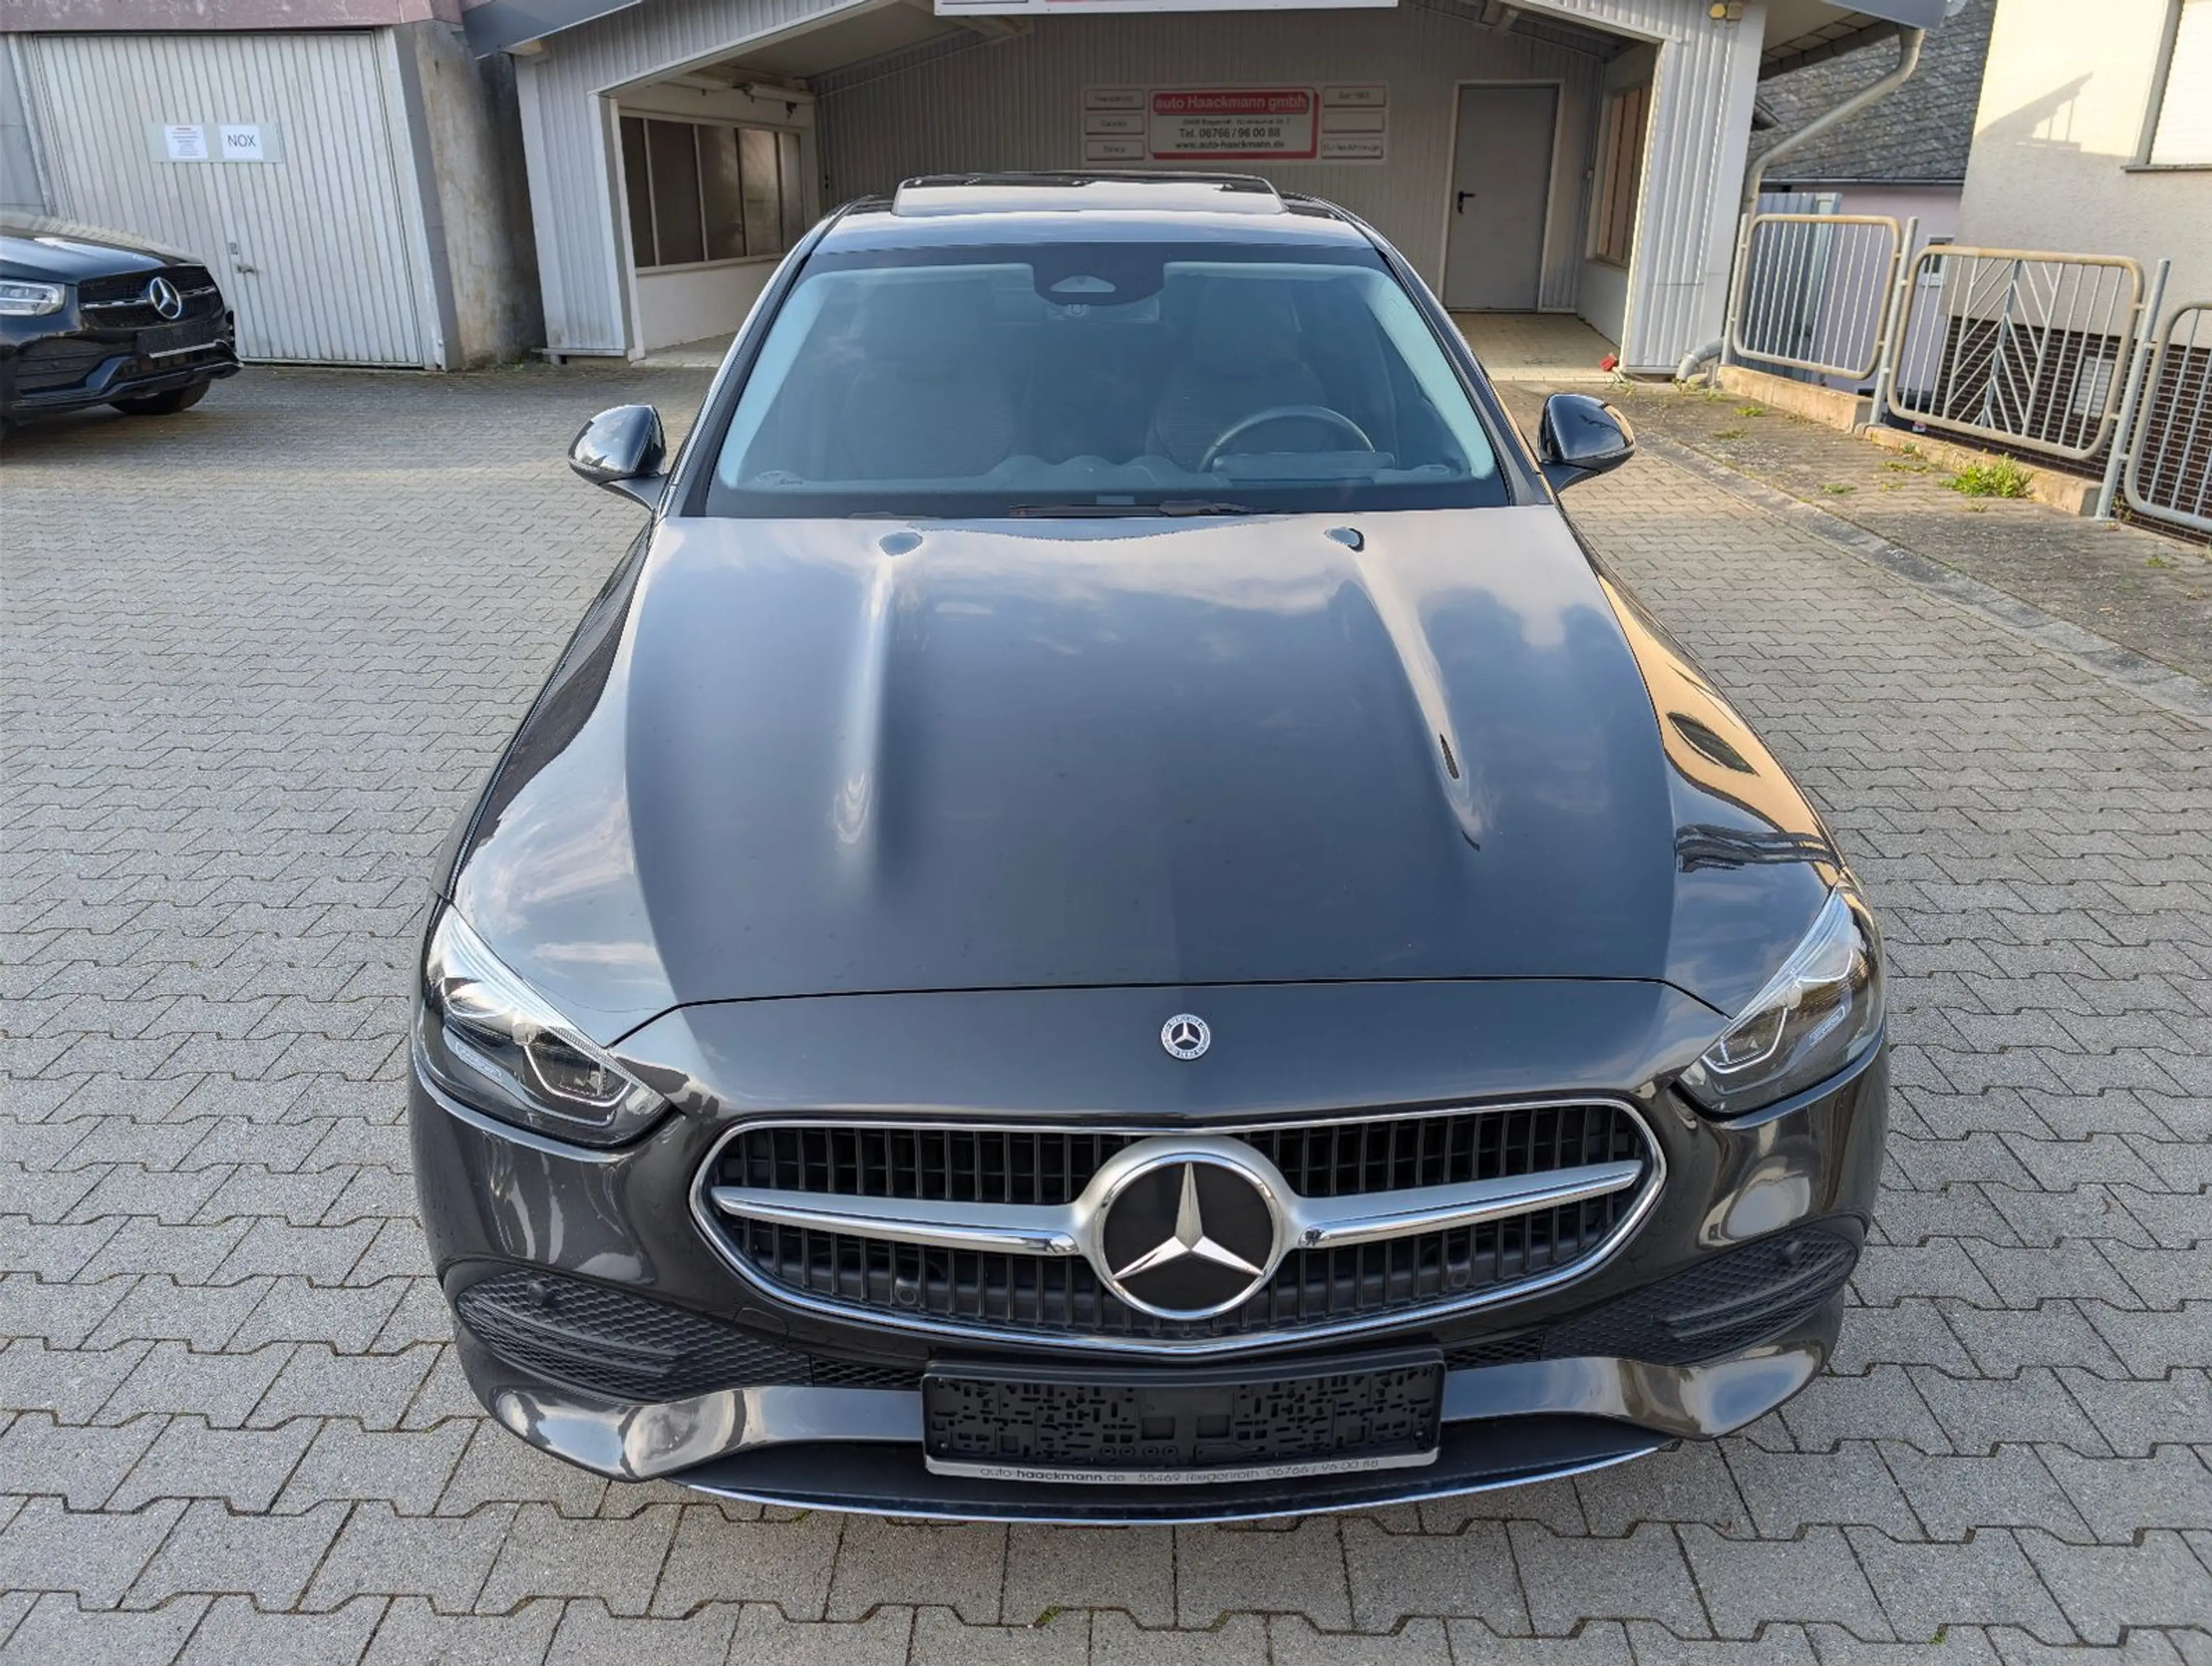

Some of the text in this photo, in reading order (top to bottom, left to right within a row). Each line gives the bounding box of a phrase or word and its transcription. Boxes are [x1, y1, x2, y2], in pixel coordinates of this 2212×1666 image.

[1155, 95, 1306, 110] auto Haackmann gmbh
[228, 134, 256, 148] NOX
[1178, 129, 1195, 139] Tel.
[1175, 141, 1284, 149] www.auto-haackmann.de
[980, 1468, 1011, 1477] auto
[1017, 1469, 1125, 1481] haackmann.de
[1139, 1472, 1181, 1481] 55469
[1186, 1469, 1260, 1482] Riegenroth
[1267, 1466, 1308, 1477] 06766
[1322, 1462, 1338, 1470] 96
[1342, 1461, 1358, 1469] 00
